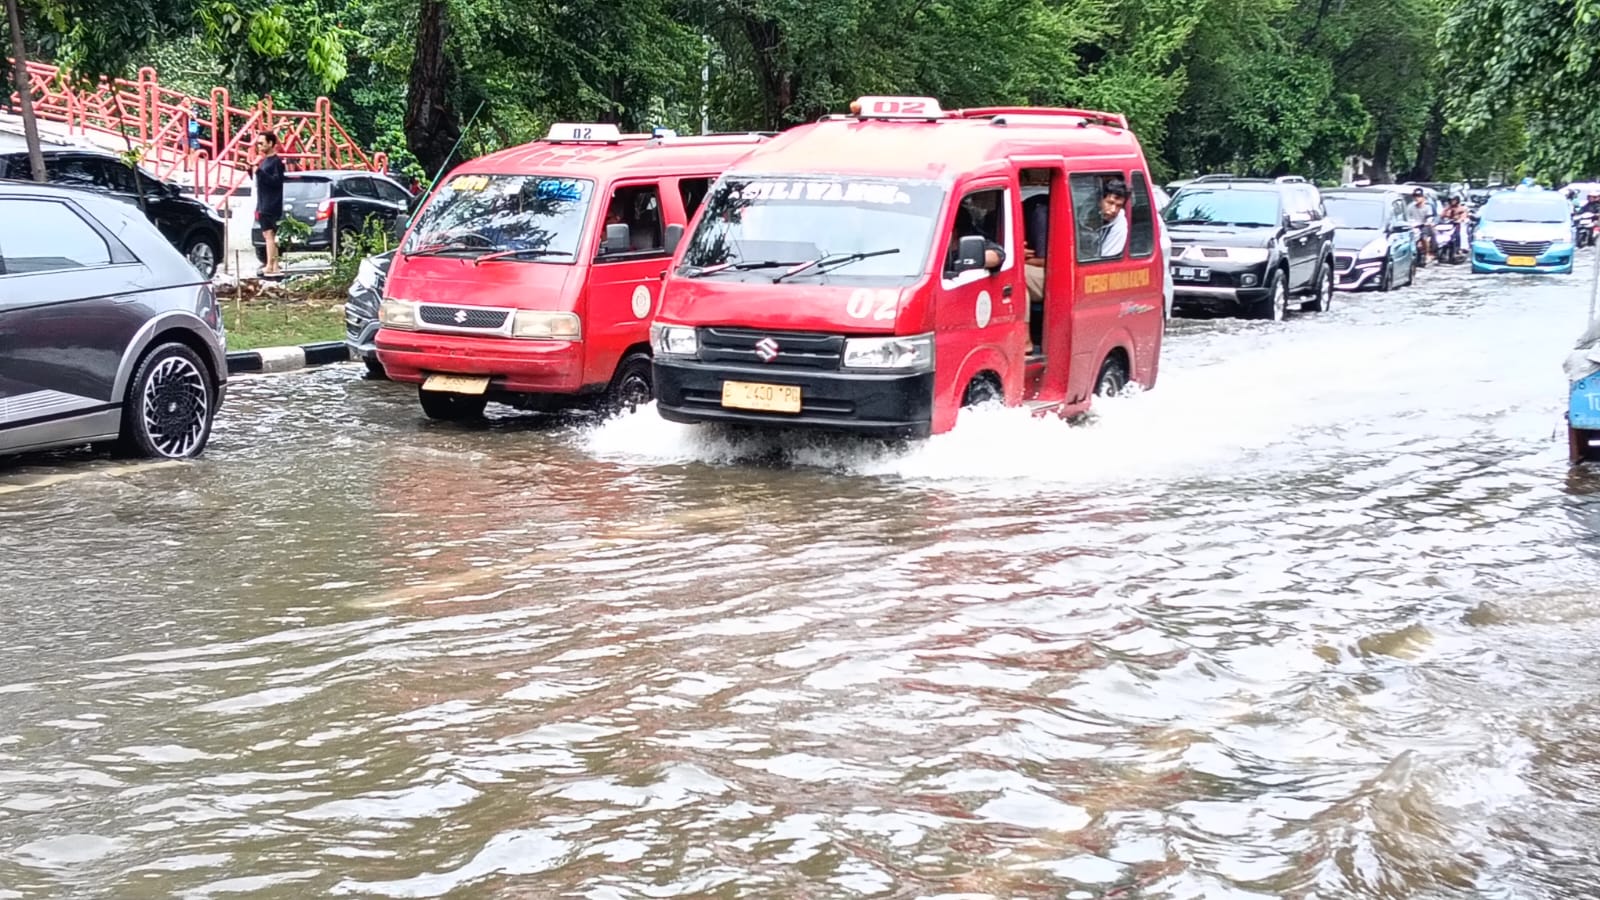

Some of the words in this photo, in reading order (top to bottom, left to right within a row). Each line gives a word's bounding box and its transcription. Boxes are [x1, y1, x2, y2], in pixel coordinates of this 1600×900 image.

[873, 101, 926, 114] 02
[573, 127, 592, 139] 02
[846, 287, 898, 321] 02
